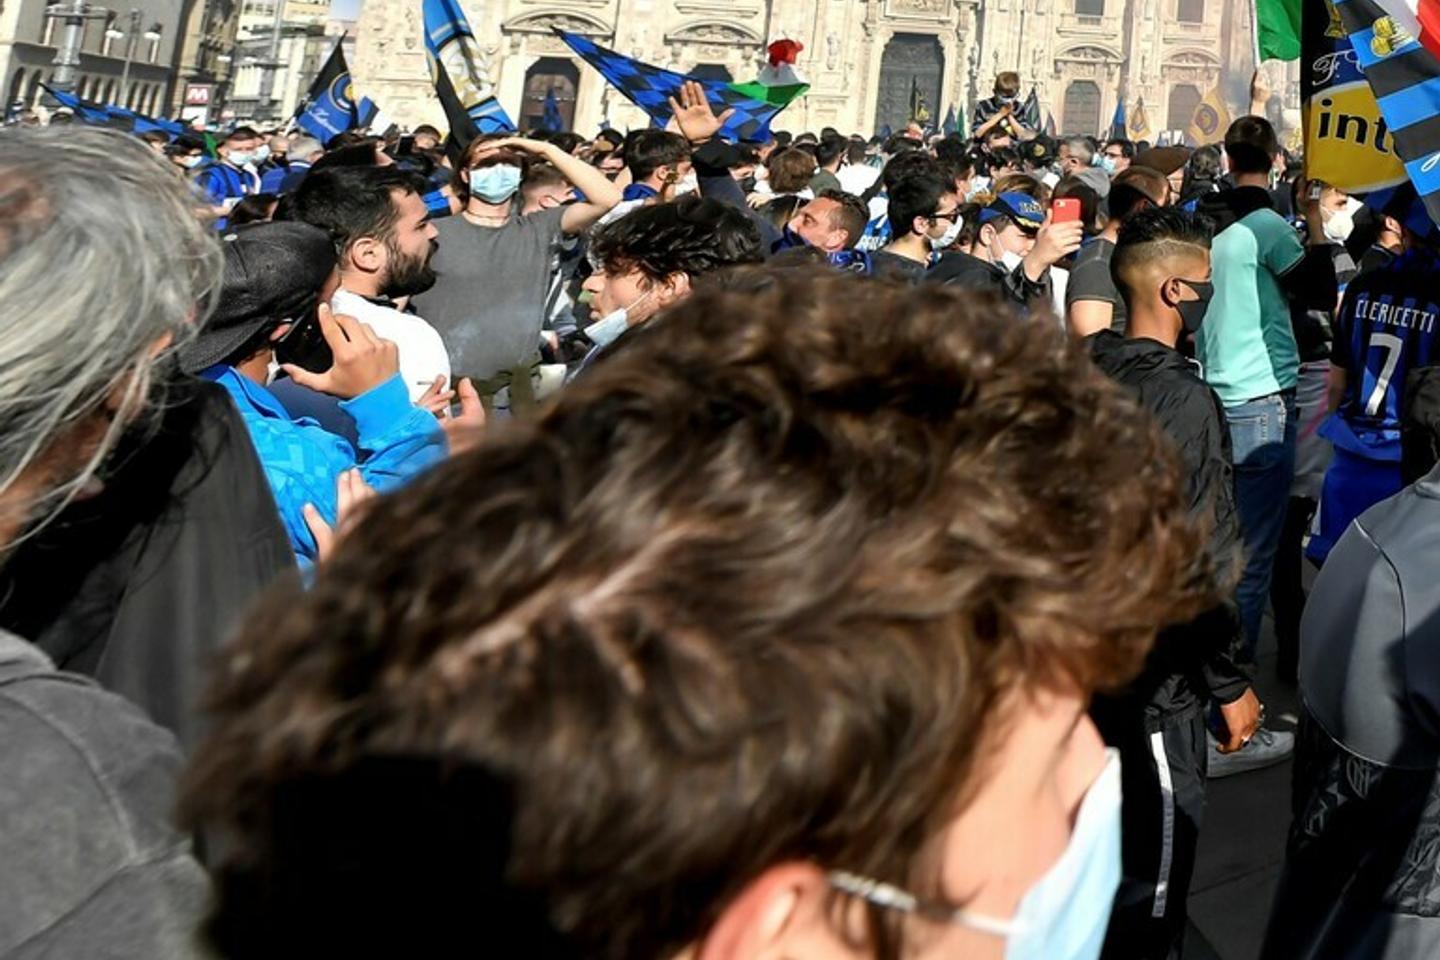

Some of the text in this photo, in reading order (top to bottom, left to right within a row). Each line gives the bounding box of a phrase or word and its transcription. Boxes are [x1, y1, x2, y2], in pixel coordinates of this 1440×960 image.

[1317, 98, 1401, 158] int
[1355, 299, 1436, 334] CLERICETTI
[1364, 332, 1404, 417] 7
